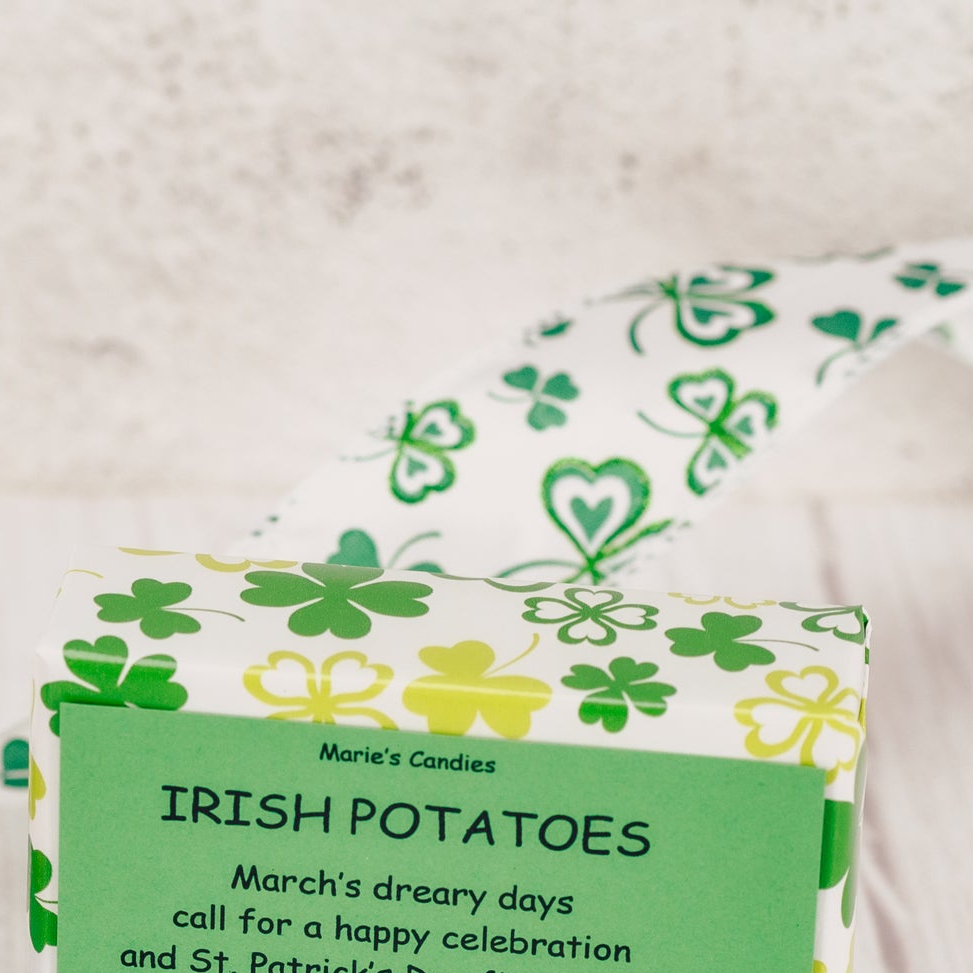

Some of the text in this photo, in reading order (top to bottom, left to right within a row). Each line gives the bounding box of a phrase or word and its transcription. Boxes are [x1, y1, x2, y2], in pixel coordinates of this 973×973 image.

[319, 742, 496, 774] Marie's Candies
[160, 784, 651, 858] IRISH POTATOES
[230, 864, 574, 921] March's dreary days
[120, 944, 177, 970] and
[172, 903, 631, 963] call for a happy celebration
